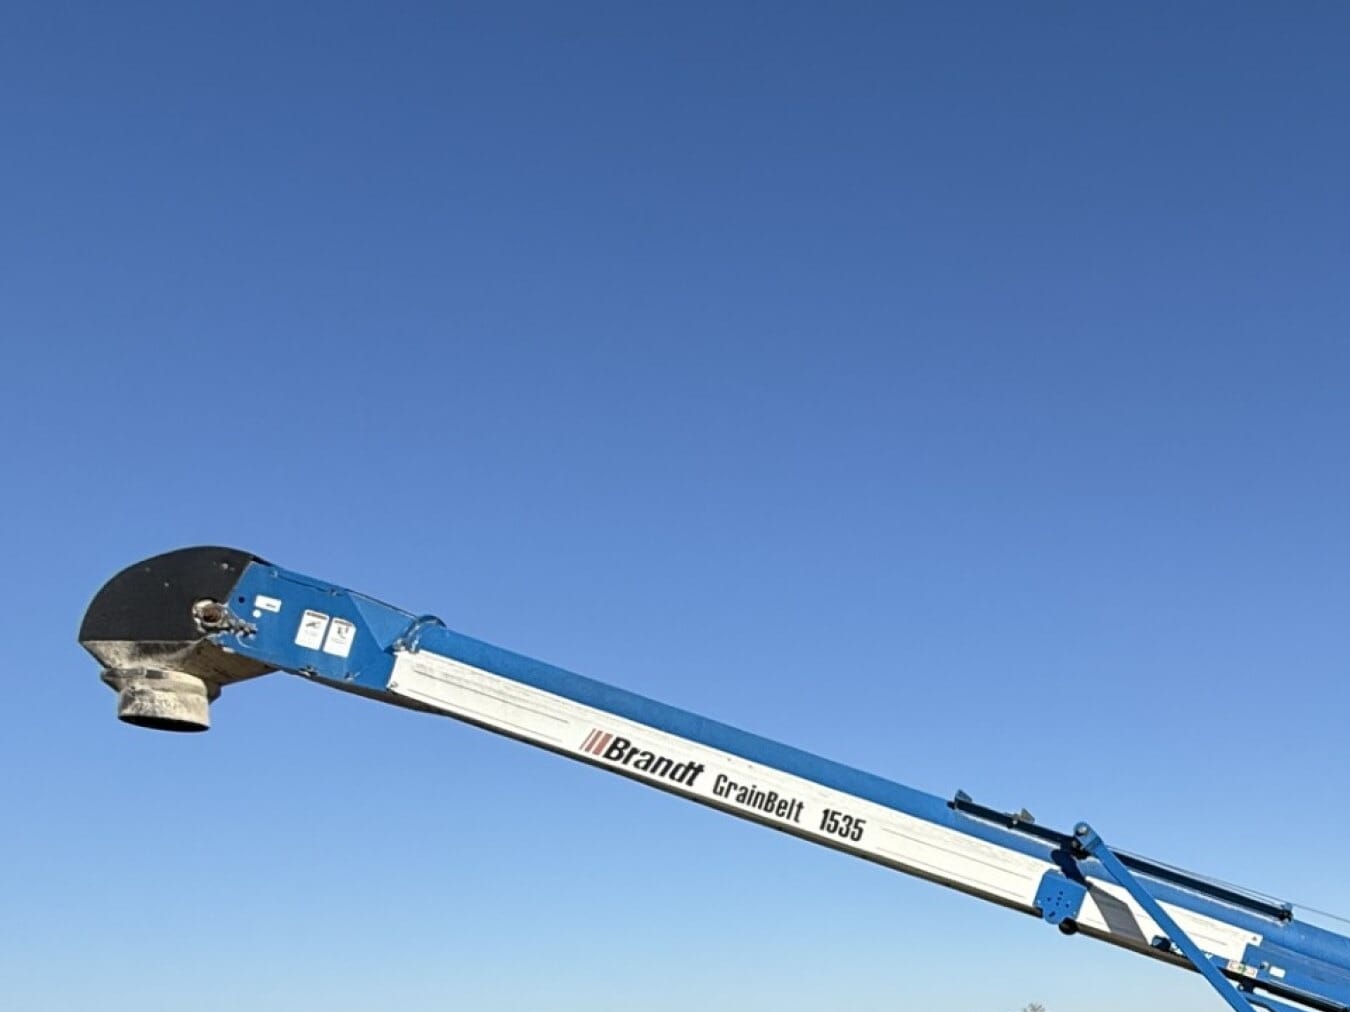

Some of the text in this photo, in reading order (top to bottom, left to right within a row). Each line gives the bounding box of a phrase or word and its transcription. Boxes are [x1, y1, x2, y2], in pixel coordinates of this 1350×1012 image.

[602, 736, 867, 842] Brandt GrainBelt 1535
